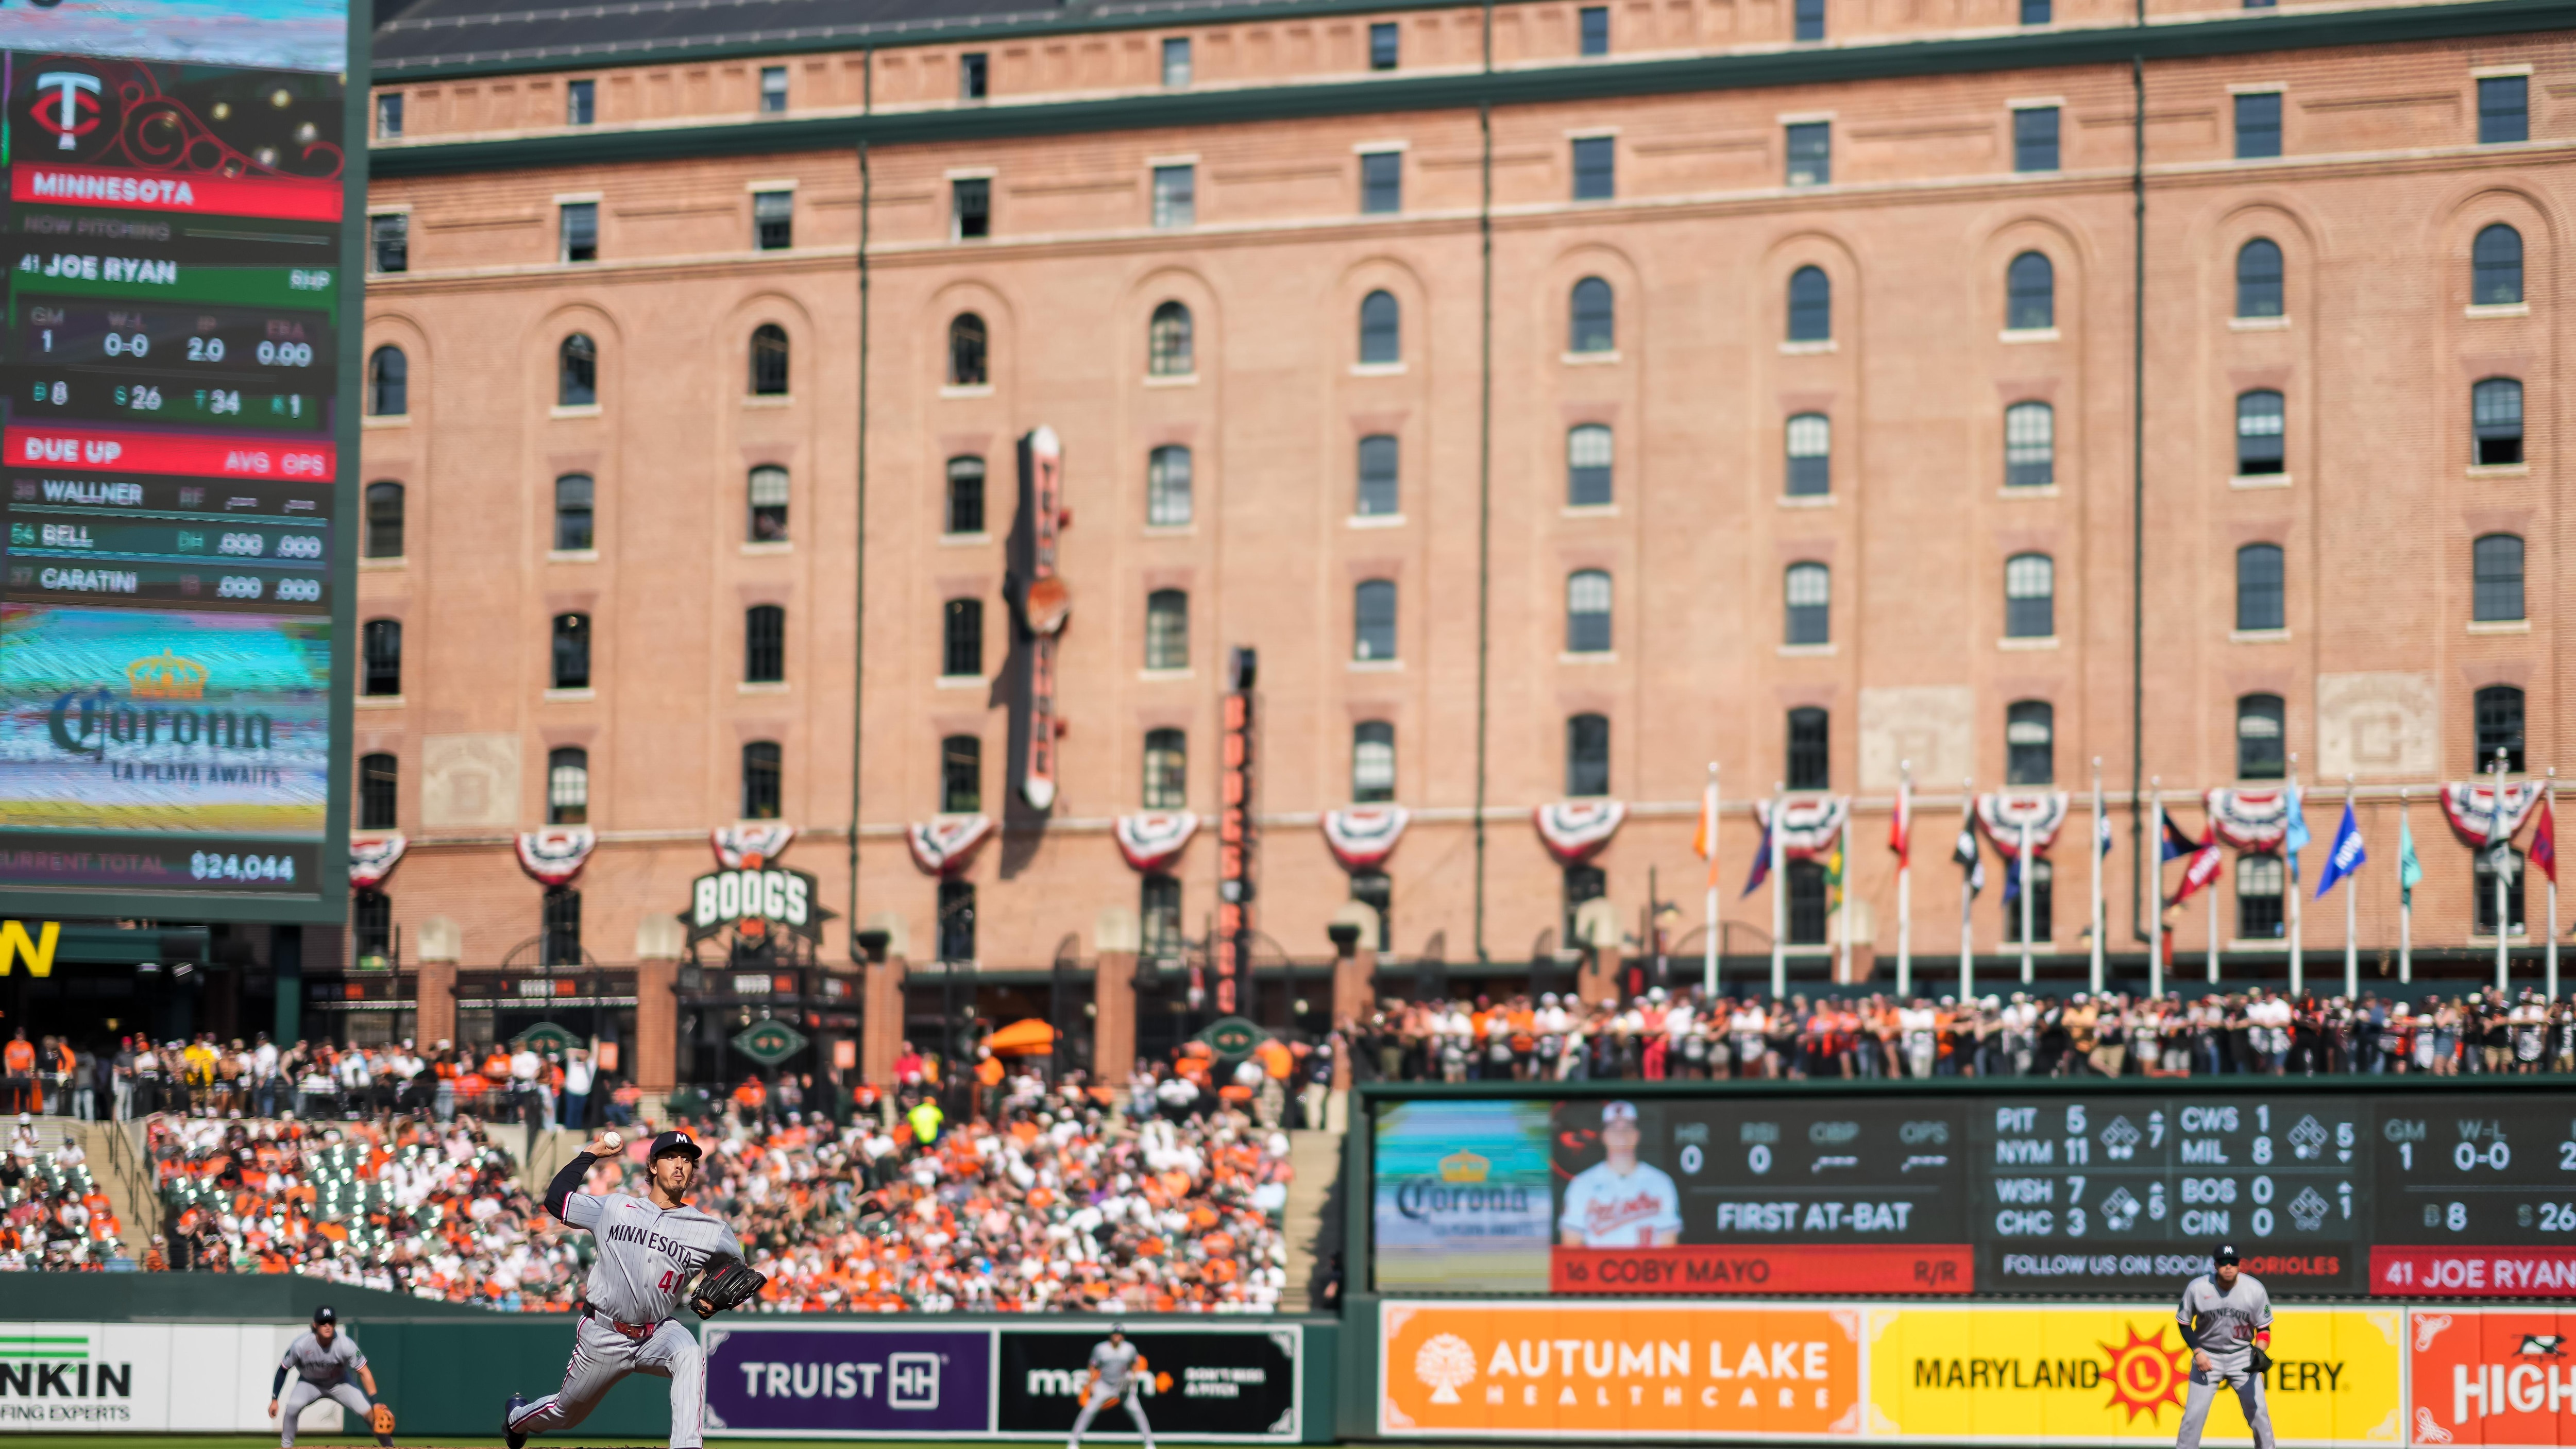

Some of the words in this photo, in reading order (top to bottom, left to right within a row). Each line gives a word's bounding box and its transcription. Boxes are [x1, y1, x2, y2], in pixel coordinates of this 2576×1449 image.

[33, 173, 194, 205] MINNESOTA
[20, 253, 40, 274] 41
[44, 253, 98, 280] JOE
[104, 257, 177, 284] RYAN
[42, 329, 52, 352] 1
[105, 333, 148, 357] 0-0
[188, 337, 225, 362] 2.0
[257, 340, 312, 367] 0.00
[52, 380, 68, 405] 8
[131, 384, 162, 411] 26
[211, 388, 241, 415] 34
[290, 393, 301, 418] 1
[25, 436, 78, 463] DUE
[86, 440, 122, 464] UP
[225, 450, 270, 474] AVG
[281, 453, 326, 476] OPS
[42, 480, 143, 506] WALLNER
[42, 523, 93, 548] BELL
[40, 567, 137, 593] CARATINI
[48, 687, 273, 763] Corona
[112, 761, 134, 782] LA
[142, 762, 200, 785] PLAYA
[208, 764, 282, 787] AWAITS
[98, 853, 168, 875] TOTAL
[190, 849, 295, 882] $24,044
[696, 870, 808, 928] BOOGS
[1996, 1107, 2038, 1133] PIT
[2066, 1105, 2087, 1134] 5
[2180, 1105, 2240, 1132] CWS
[2256, 1104, 2269, 1132] 1
[676, 1133, 688, 1143] M
[1996, 1139, 2054, 1165] NYM
[2065, 1137, 2089, 1165] 11
[2181, 1139, 2229, 1165] MIL
[2252, 1136, 2274, 1165] 8
[1680, 1145, 1704, 1174] 0
[1748, 1145, 1772, 1174] 0
[2399, 1141, 2413, 1171] 1
[2454, 1141, 2511, 1171] 0-0
[1396, 1179, 1528, 1220] Corona
[1995, 1178, 2053, 1203] WSH
[2066, 1175, 2086, 1204] 7
[2181, 1178, 2237, 1203] BOS
[2251, 1175, 2274, 1204] 0
[1717, 1202, 1801, 1231] FIRST
[1804, 1202, 1913, 1231] AT-BAT
[1995, 1209, 2054, 1235] CHC
[2066, 1207, 2087, 1237] 3
[2181, 1209, 2230, 1235] CIN
[2251, 1207, 2274, 1237] 0
[2446, 1201, 2468, 1231] 8
[2539, 1202, 2576, 1231] 26
[606, 1224, 692, 1269] MINNESOTA
[1565, 1262, 1589, 1282] 16
[1598, 1259, 1675, 1284] COBY
[1685, 1259, 1771, 1284] MAYO
[1913, 1260, 1958, 1286] R/R
[2003, 1254, 2086, 1275] FOLLOW
[2089, 1255, 2117, 1275] US
[2119, 1254, 2151, 1275] ON
[2155, 1254, 2217, 1275] SOCIA
[2386, 1260, 2413, 1286] 41
[2422, 1259, 2486, 1288] JOE
[2494, 1259, 2576, 1288] RYAN
[658, 1270, 685, 1294] 41
[1487, 1339, 1691, 1377] AUTUMN
[1710, 1341, 1829, 1380] LAKE
[1914, 1358, 2100, 1389] MARYLAND
[0, 1363, 131, 1397] NKIN
[739, 1362, 883, 1399] TRUIST
[1027, 1368, 1156, 1397] man
[2453, 1363, 2576, 1425] HIGH
[1485, 1385, 1829, 1409] HEALTHCARE
[50, 1404, 131, 1422] EXPERTS
